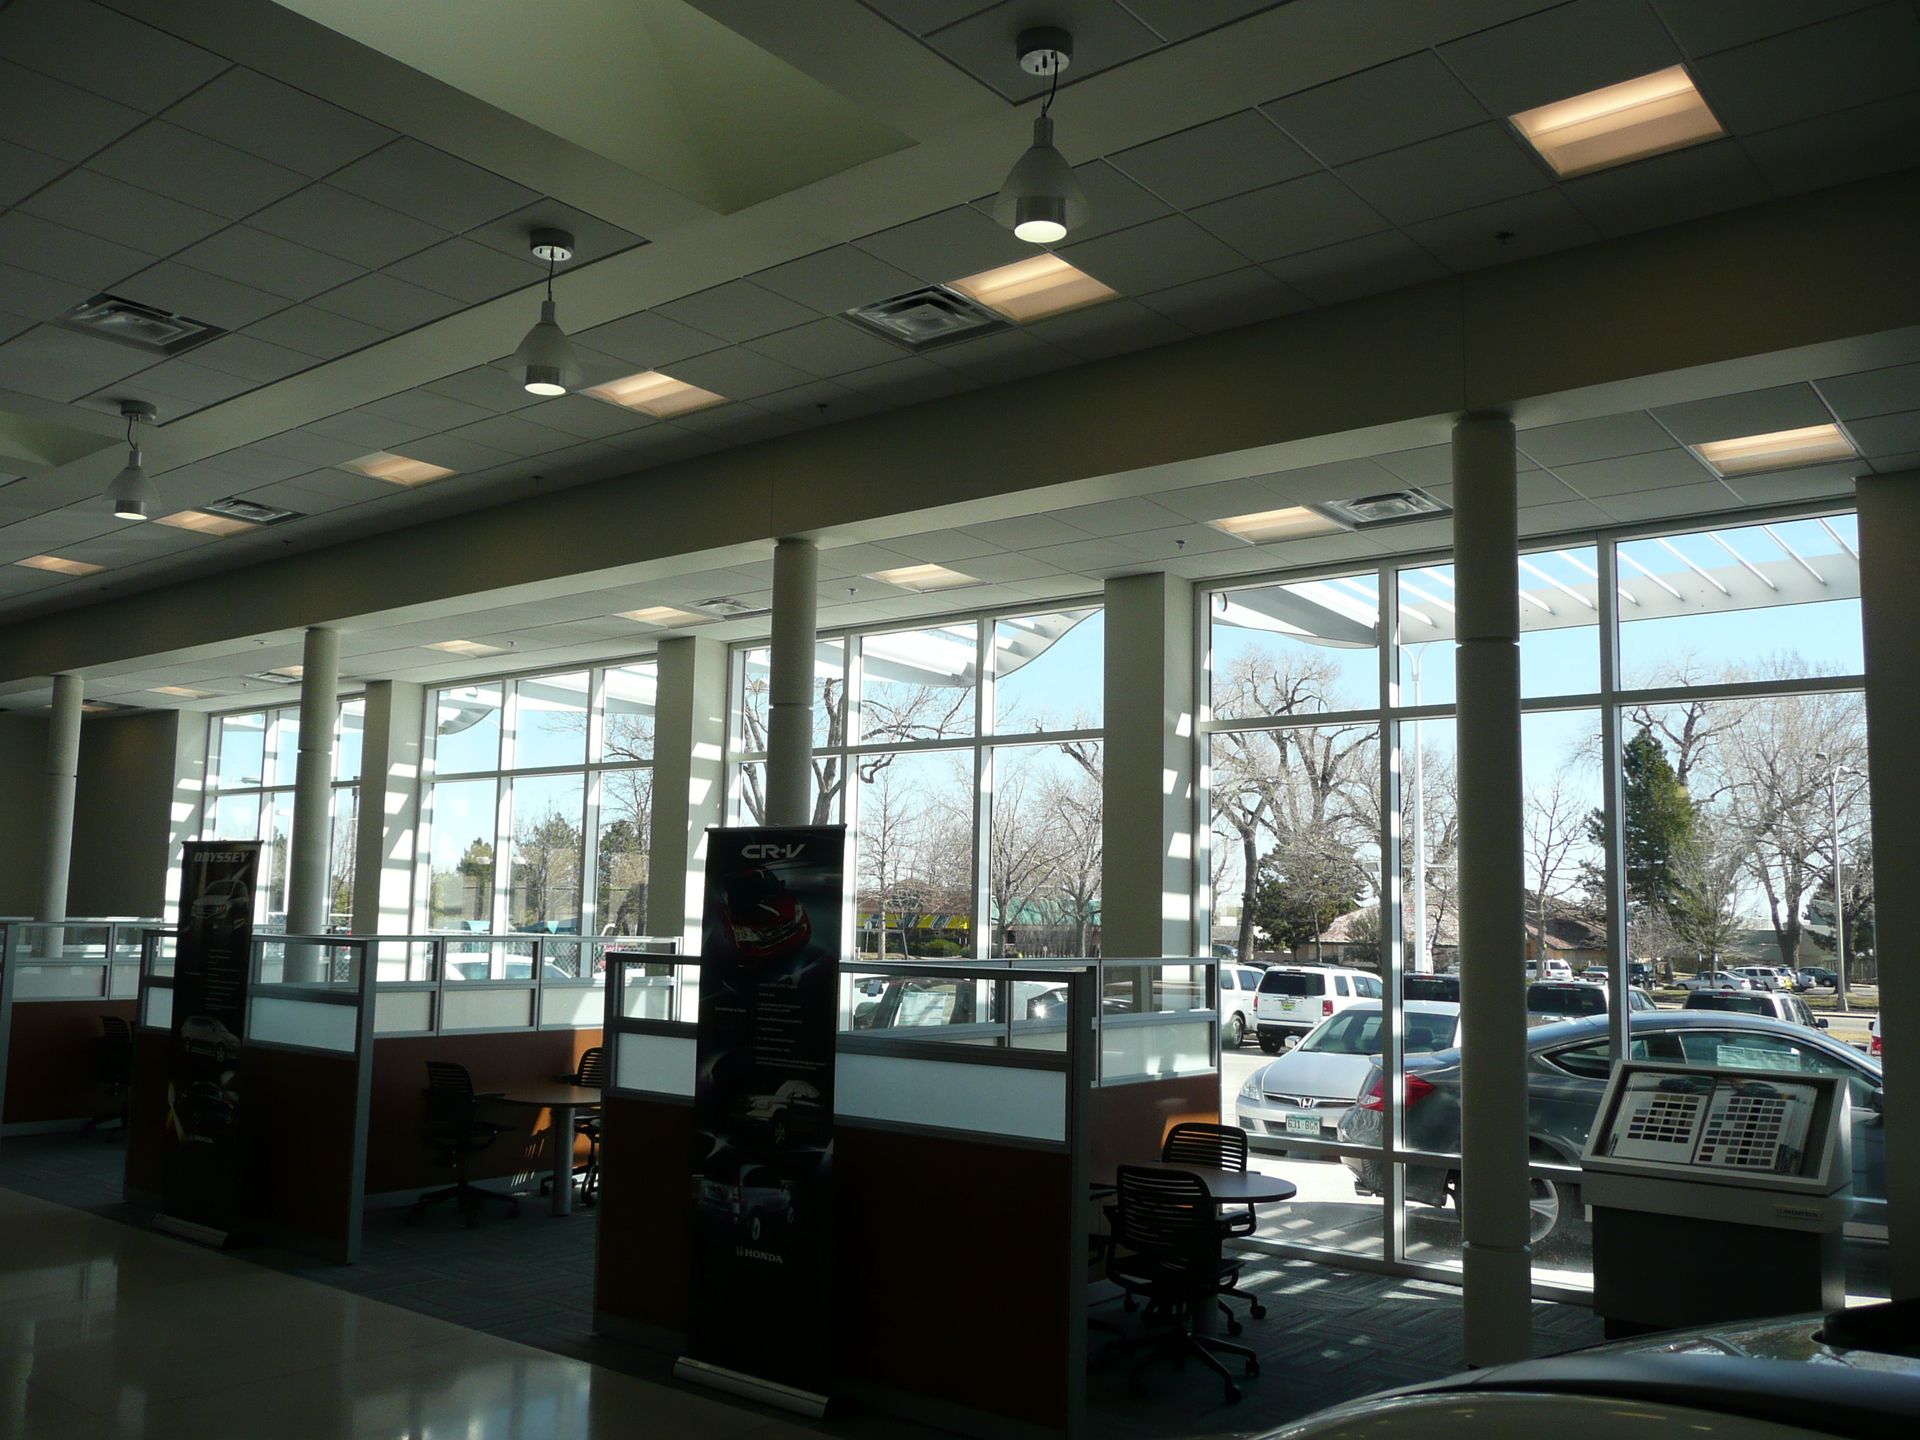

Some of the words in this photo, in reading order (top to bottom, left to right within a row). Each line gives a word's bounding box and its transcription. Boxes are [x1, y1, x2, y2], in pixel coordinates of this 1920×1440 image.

[194, 851, 249, 864] ODYSSEY
[741, 843, 806, 859] CR-V
[744, 1248, 783, 1263] HONDA
